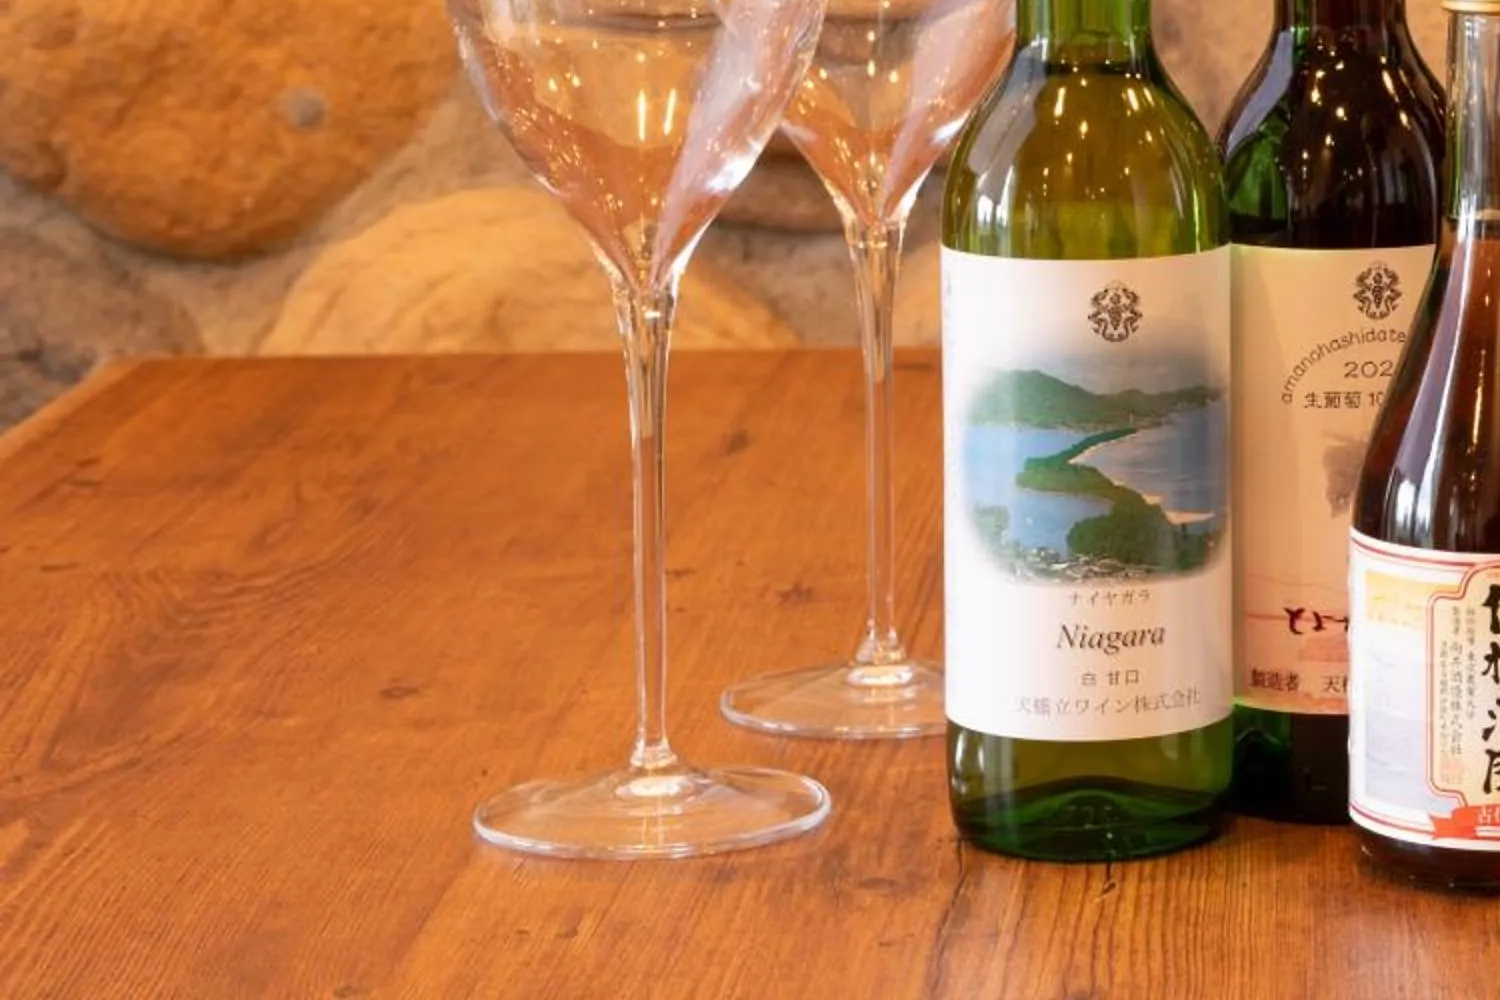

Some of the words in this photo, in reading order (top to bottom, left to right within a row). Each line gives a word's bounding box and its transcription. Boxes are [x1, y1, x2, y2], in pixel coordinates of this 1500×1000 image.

[1343, 360, 1393, 379] 202
[1056, 623, 1167, 655] Niagara
[1107, 668, 1140, 687] 甘口
